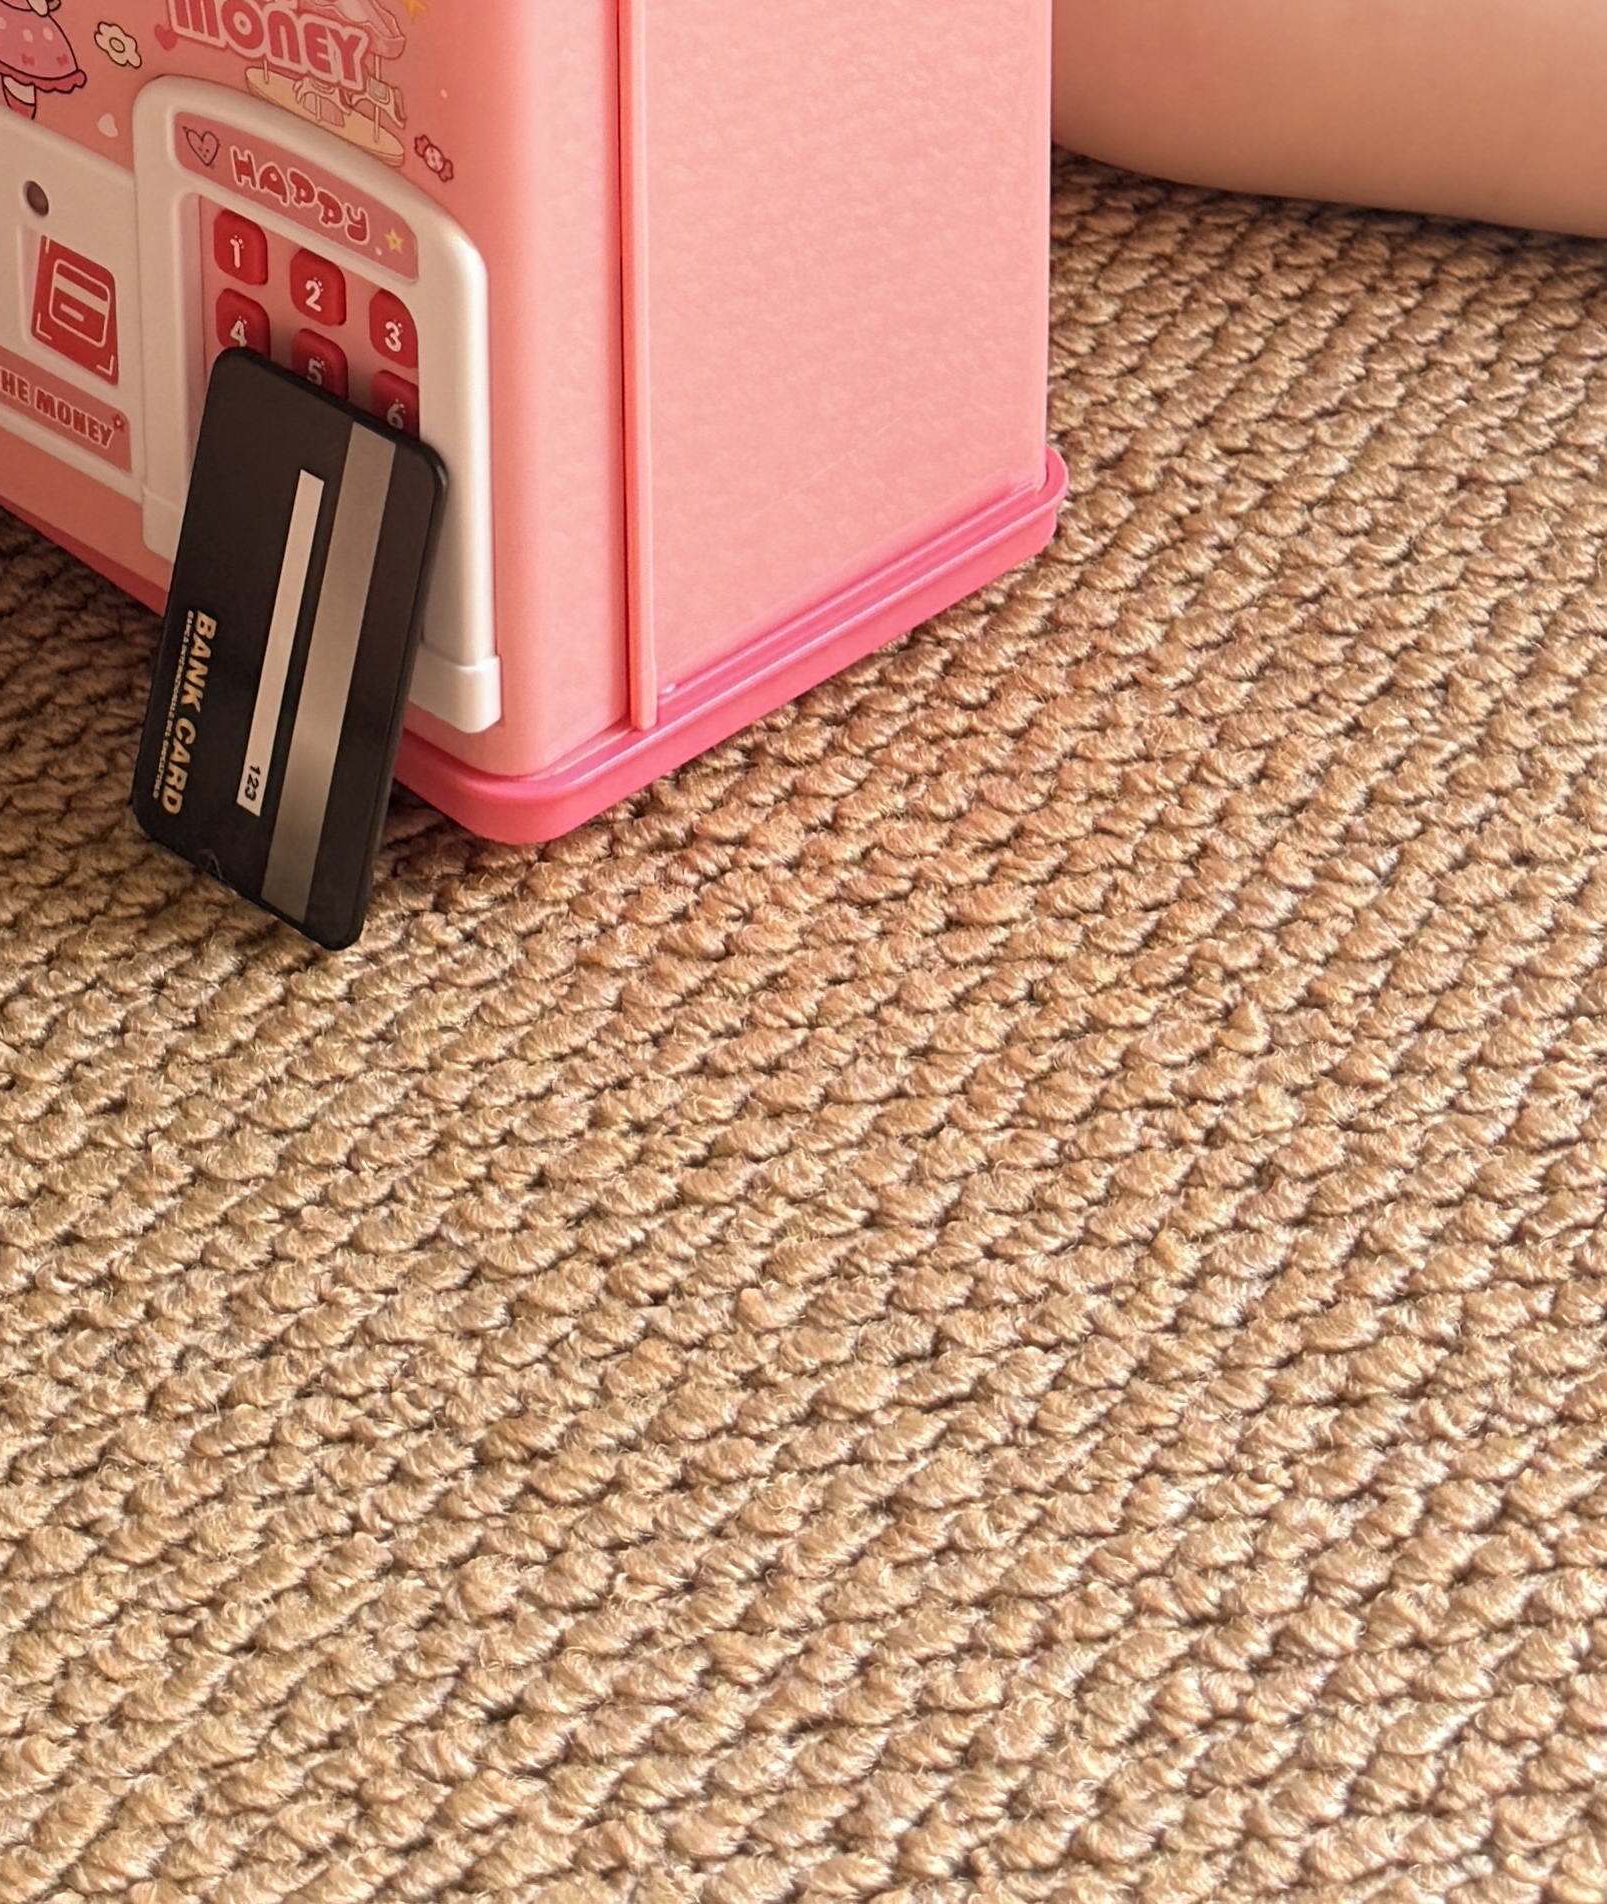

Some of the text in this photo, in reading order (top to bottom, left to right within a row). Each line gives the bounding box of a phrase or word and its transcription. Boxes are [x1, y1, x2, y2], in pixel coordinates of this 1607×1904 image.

[230, 145, 371, 243] HAPPY
[229, 236, 403, 352] 1 2 3
[34, 386, 114, 449] MONEY
[230, 317, 404, 430] 4 5 6
[162, 610, 217, 814] BANK CARD
[244, 765, 261, 801] 123
